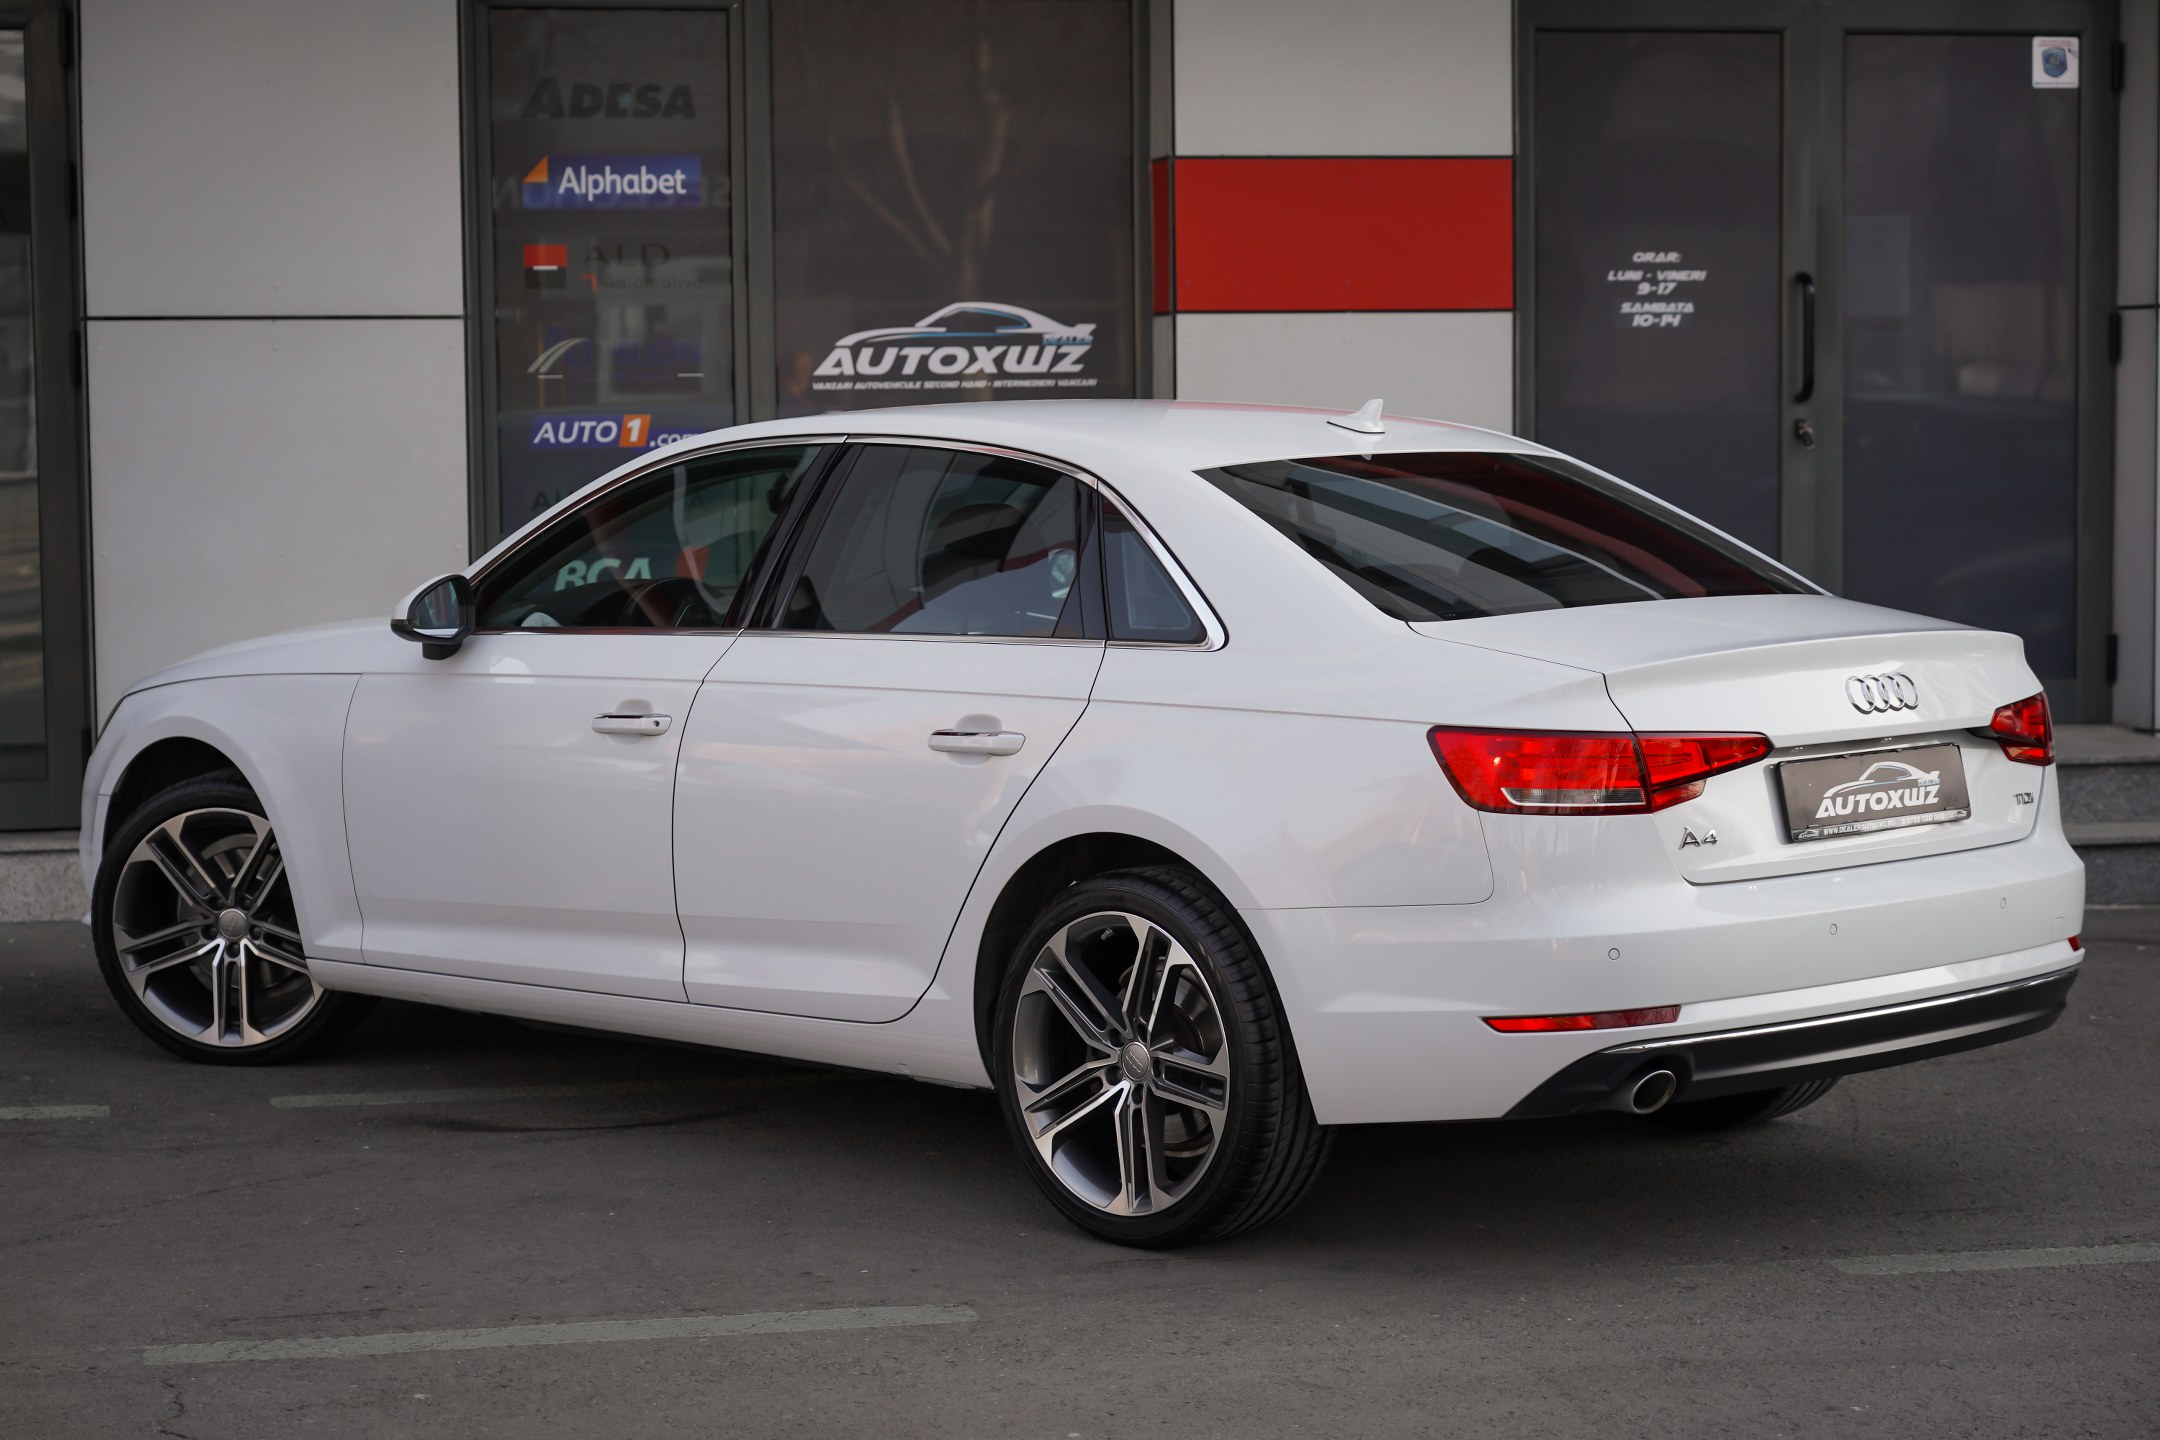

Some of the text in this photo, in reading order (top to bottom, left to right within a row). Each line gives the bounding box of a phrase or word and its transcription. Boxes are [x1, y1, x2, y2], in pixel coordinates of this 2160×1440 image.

[557, 165, 687, 201] Alphabet
[582, 244, 672, 267] ALD
[1607, 270, 1643, 281] LUNI
[1656, 270, 1707, 281] VINERI
[1636, 281, 1677, 295] 9-17
[1620, 302, 1695, 313] SAMBATA
[1632, 314, 1682, 327] 10-14
[812, 345, 1093, 377] AUTOXWZ
[812, 381, 854, 391] VANZARI
[923, 380, 960, 390] SECOND
[1815, 785, 1941, 819] AUTOXWZ
[1679, 826, 1718, 850] A4
